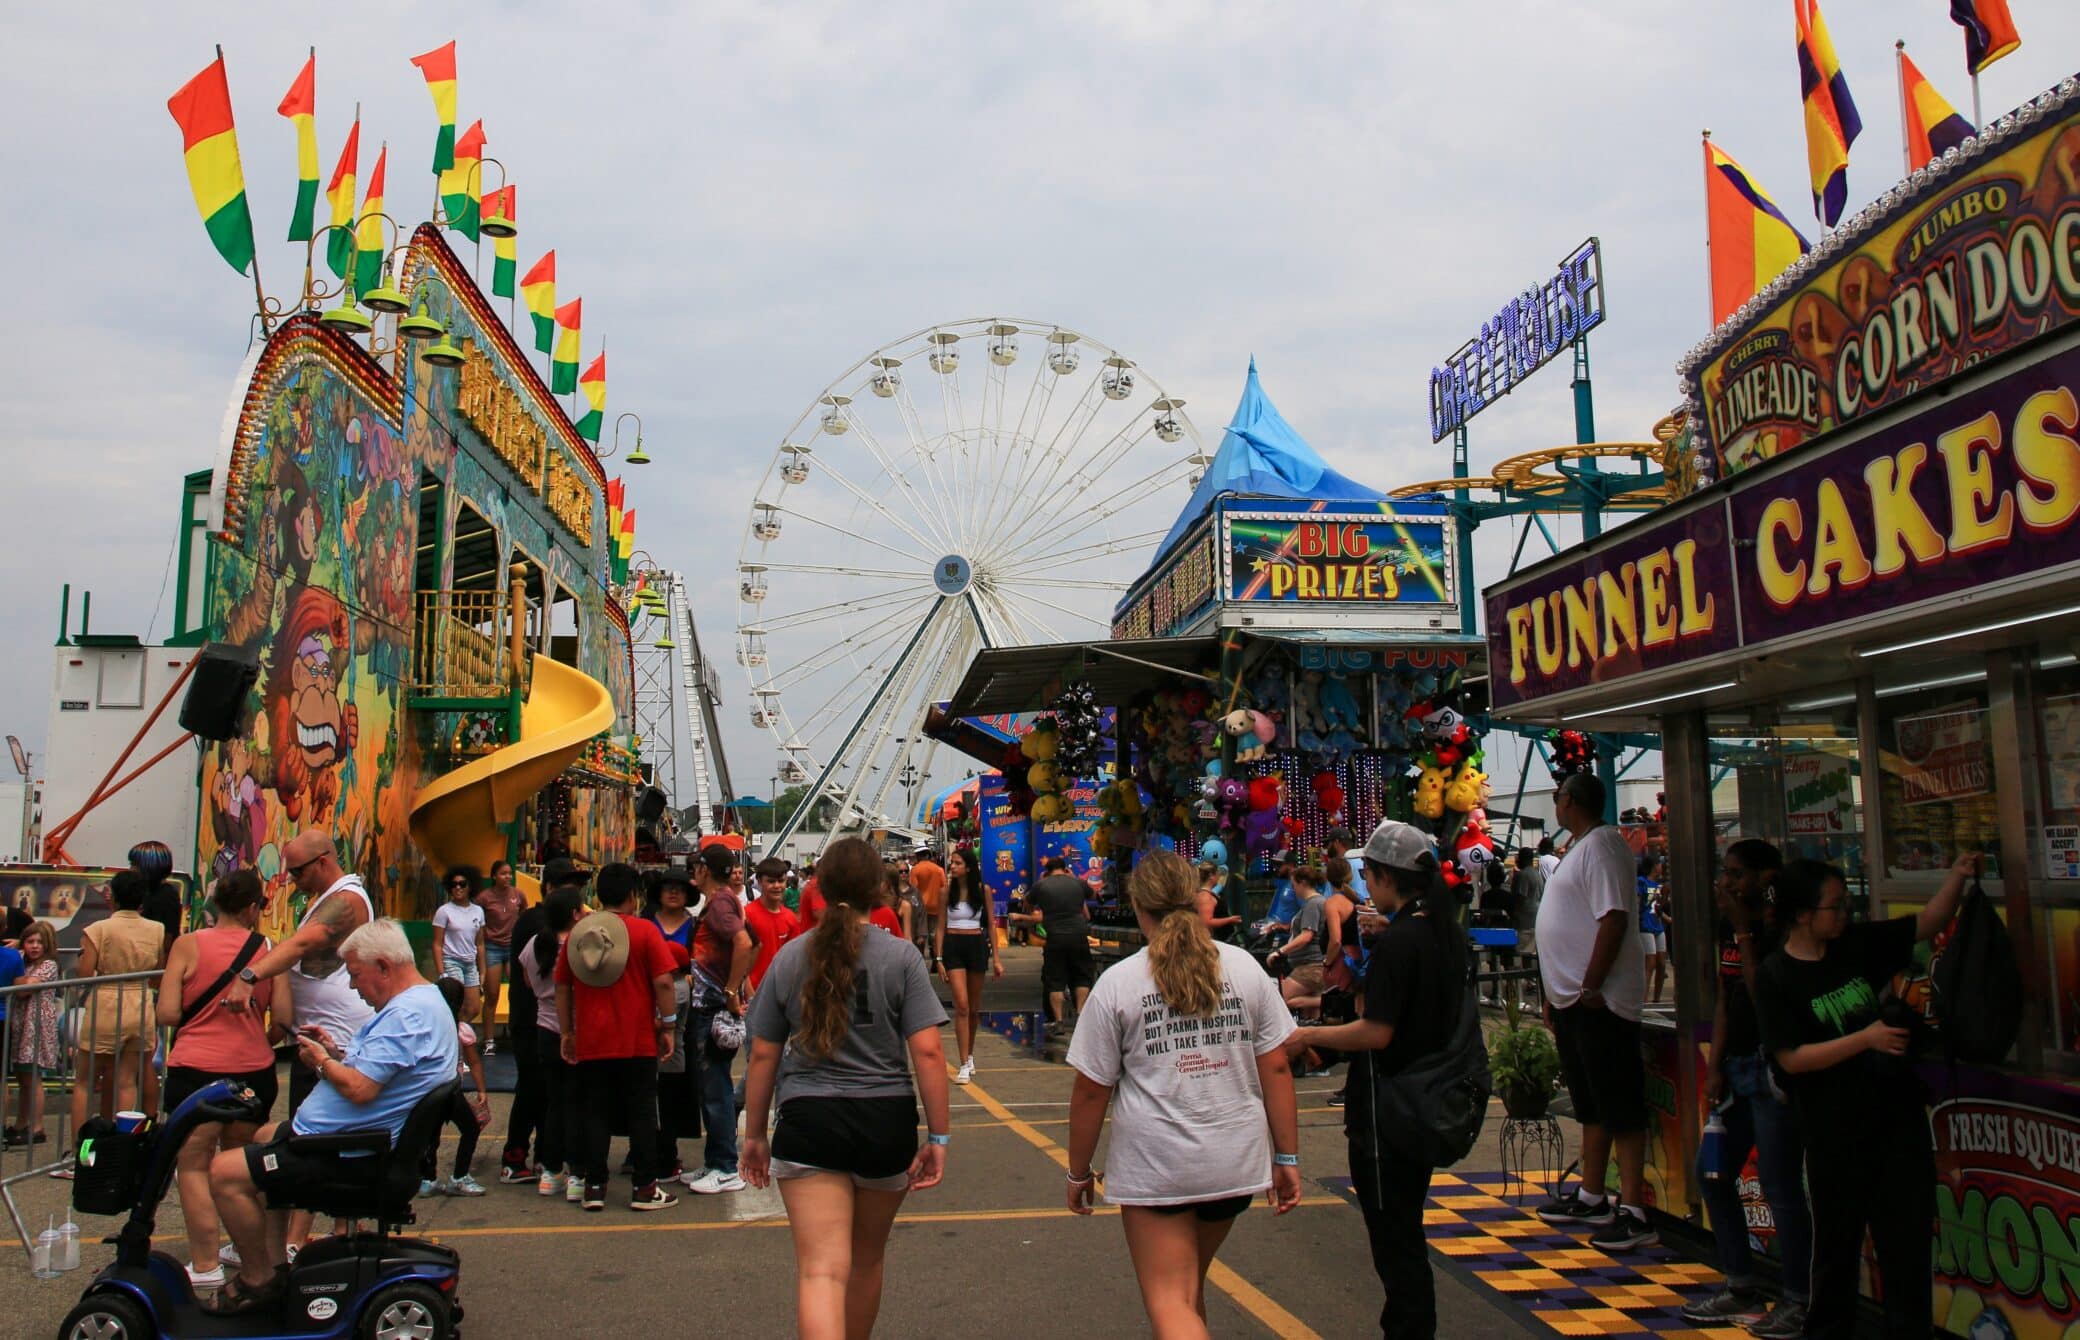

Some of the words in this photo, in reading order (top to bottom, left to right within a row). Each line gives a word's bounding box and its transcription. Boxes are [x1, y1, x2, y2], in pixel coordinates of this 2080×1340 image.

[1908, 186, 2008, 262] JUMBO
[1429, 313, 1500, 439] CRAZY
[1500, 243, 1601, 389] MOUSE
[1730, 334, 1781, 369] CHERRY
[1836, 261, 1958, 418] CORN
[1715, 360, 1818, 444] LIMEADE
[1298, 522, 1370, 558] BIG
[1506, 538, 1715, 686] FUNNEL
[1755, 384, 2080, 607] CAKES
[1269, 563, 1400, 600] PRIZES
[1300, 646, 1372, 669] BIG
[1385, 650, 1467, 669] FUN
[1783, 757, 1821, 776] Cherry
[1903, 768, 1949, 801] FUNNEL
[1949, 760, 1985, 793] CAKES
[2045, 828, 2057, 838] WE
[2058, 827, 2078, 838] GLADLY
[2051, 839, 2075, 849] ACCEPT
[1144, 1009, 1163, 1025] MAY
[1144, 1026, 1162, 1041] BUT
[1167, 1019, 1199, 1035] PARMA
[1202, 1014, 1244, 1029] HOSPITAL
[1145, 1041, 1171, 1057] WILL
[1174, 1035, 1198, 1050] TAKE
[1227, 1031, 1237, 1043] OF
[1947, 1112, 2011, 1155] FRESH
